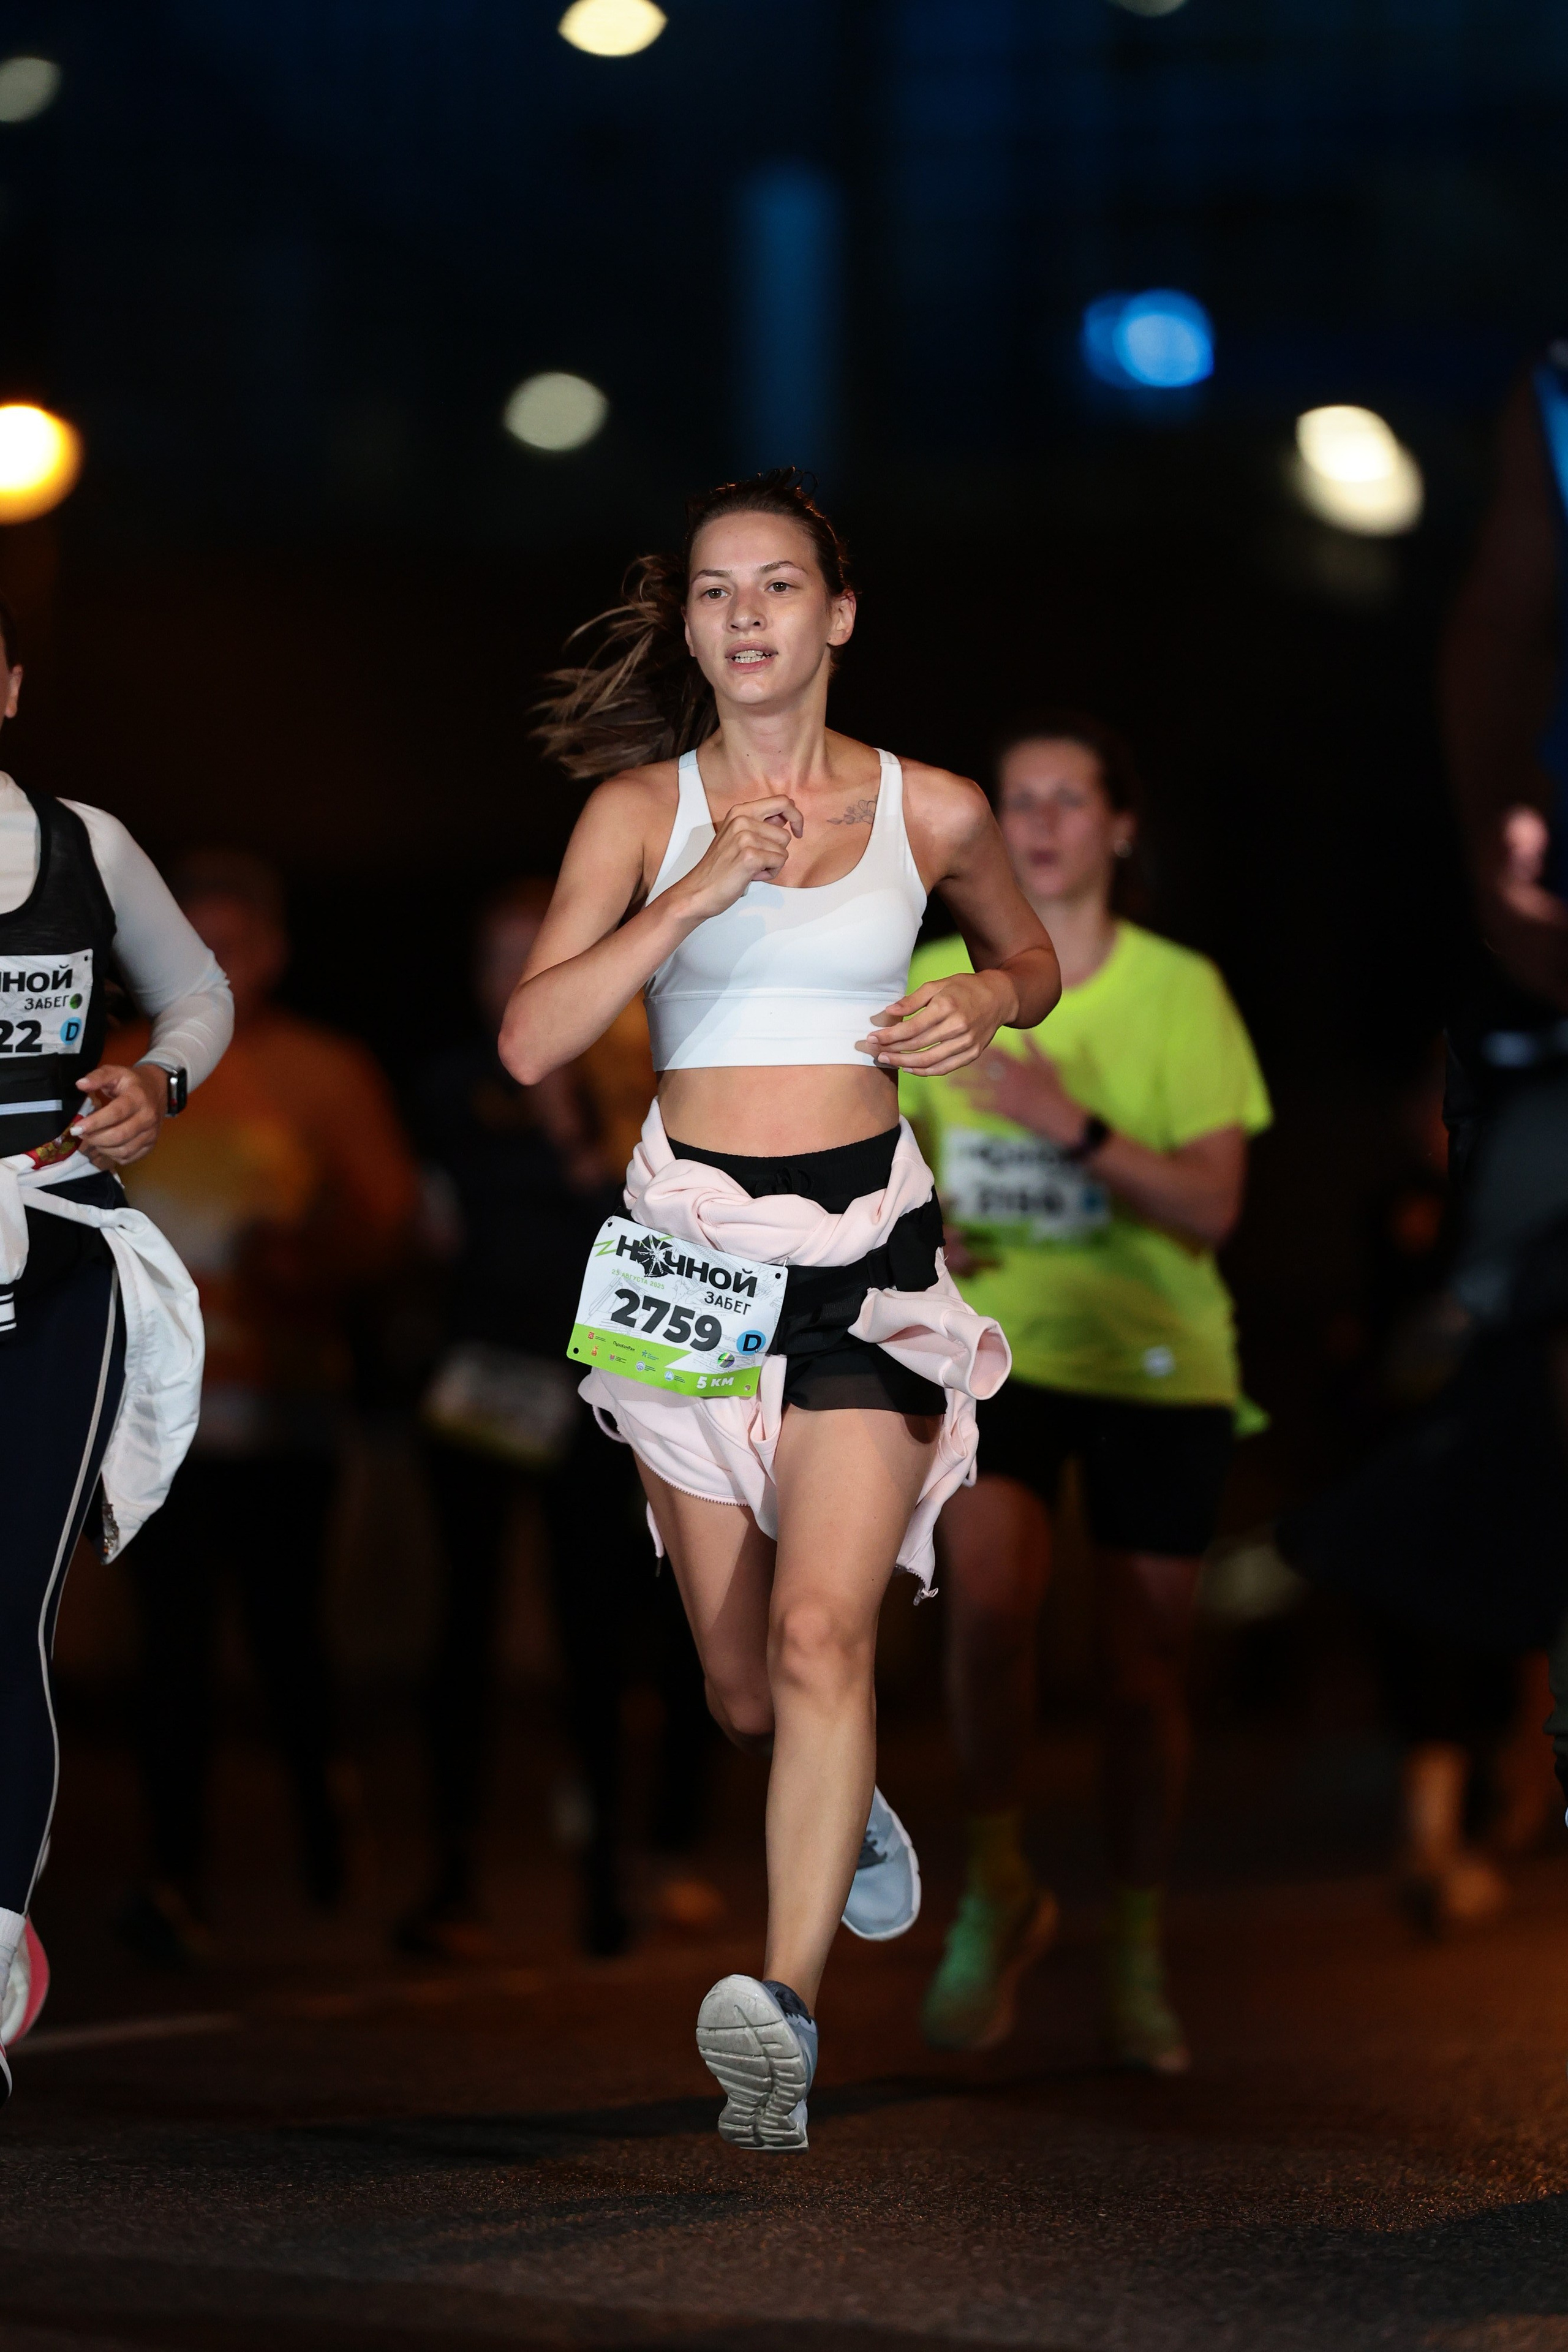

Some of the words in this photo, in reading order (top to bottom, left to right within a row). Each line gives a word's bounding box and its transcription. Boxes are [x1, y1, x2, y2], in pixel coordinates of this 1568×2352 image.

[0, 965, 73, 992] НОЙ
[24, 994, 70, 1009] ЗАБЕГ
[66, 1022, 80, 1041] D
[621, 1272, 648, 1284] АВГУСТА
[649, 1281, 665, 1289] 2025
[704, 1291, 752, 1315] ЗАБЕГ
[611, 1288, 722, 1351] 2759
[742, 1334, 762, 1352] D
[696, 1376, 707, 1389] 5
